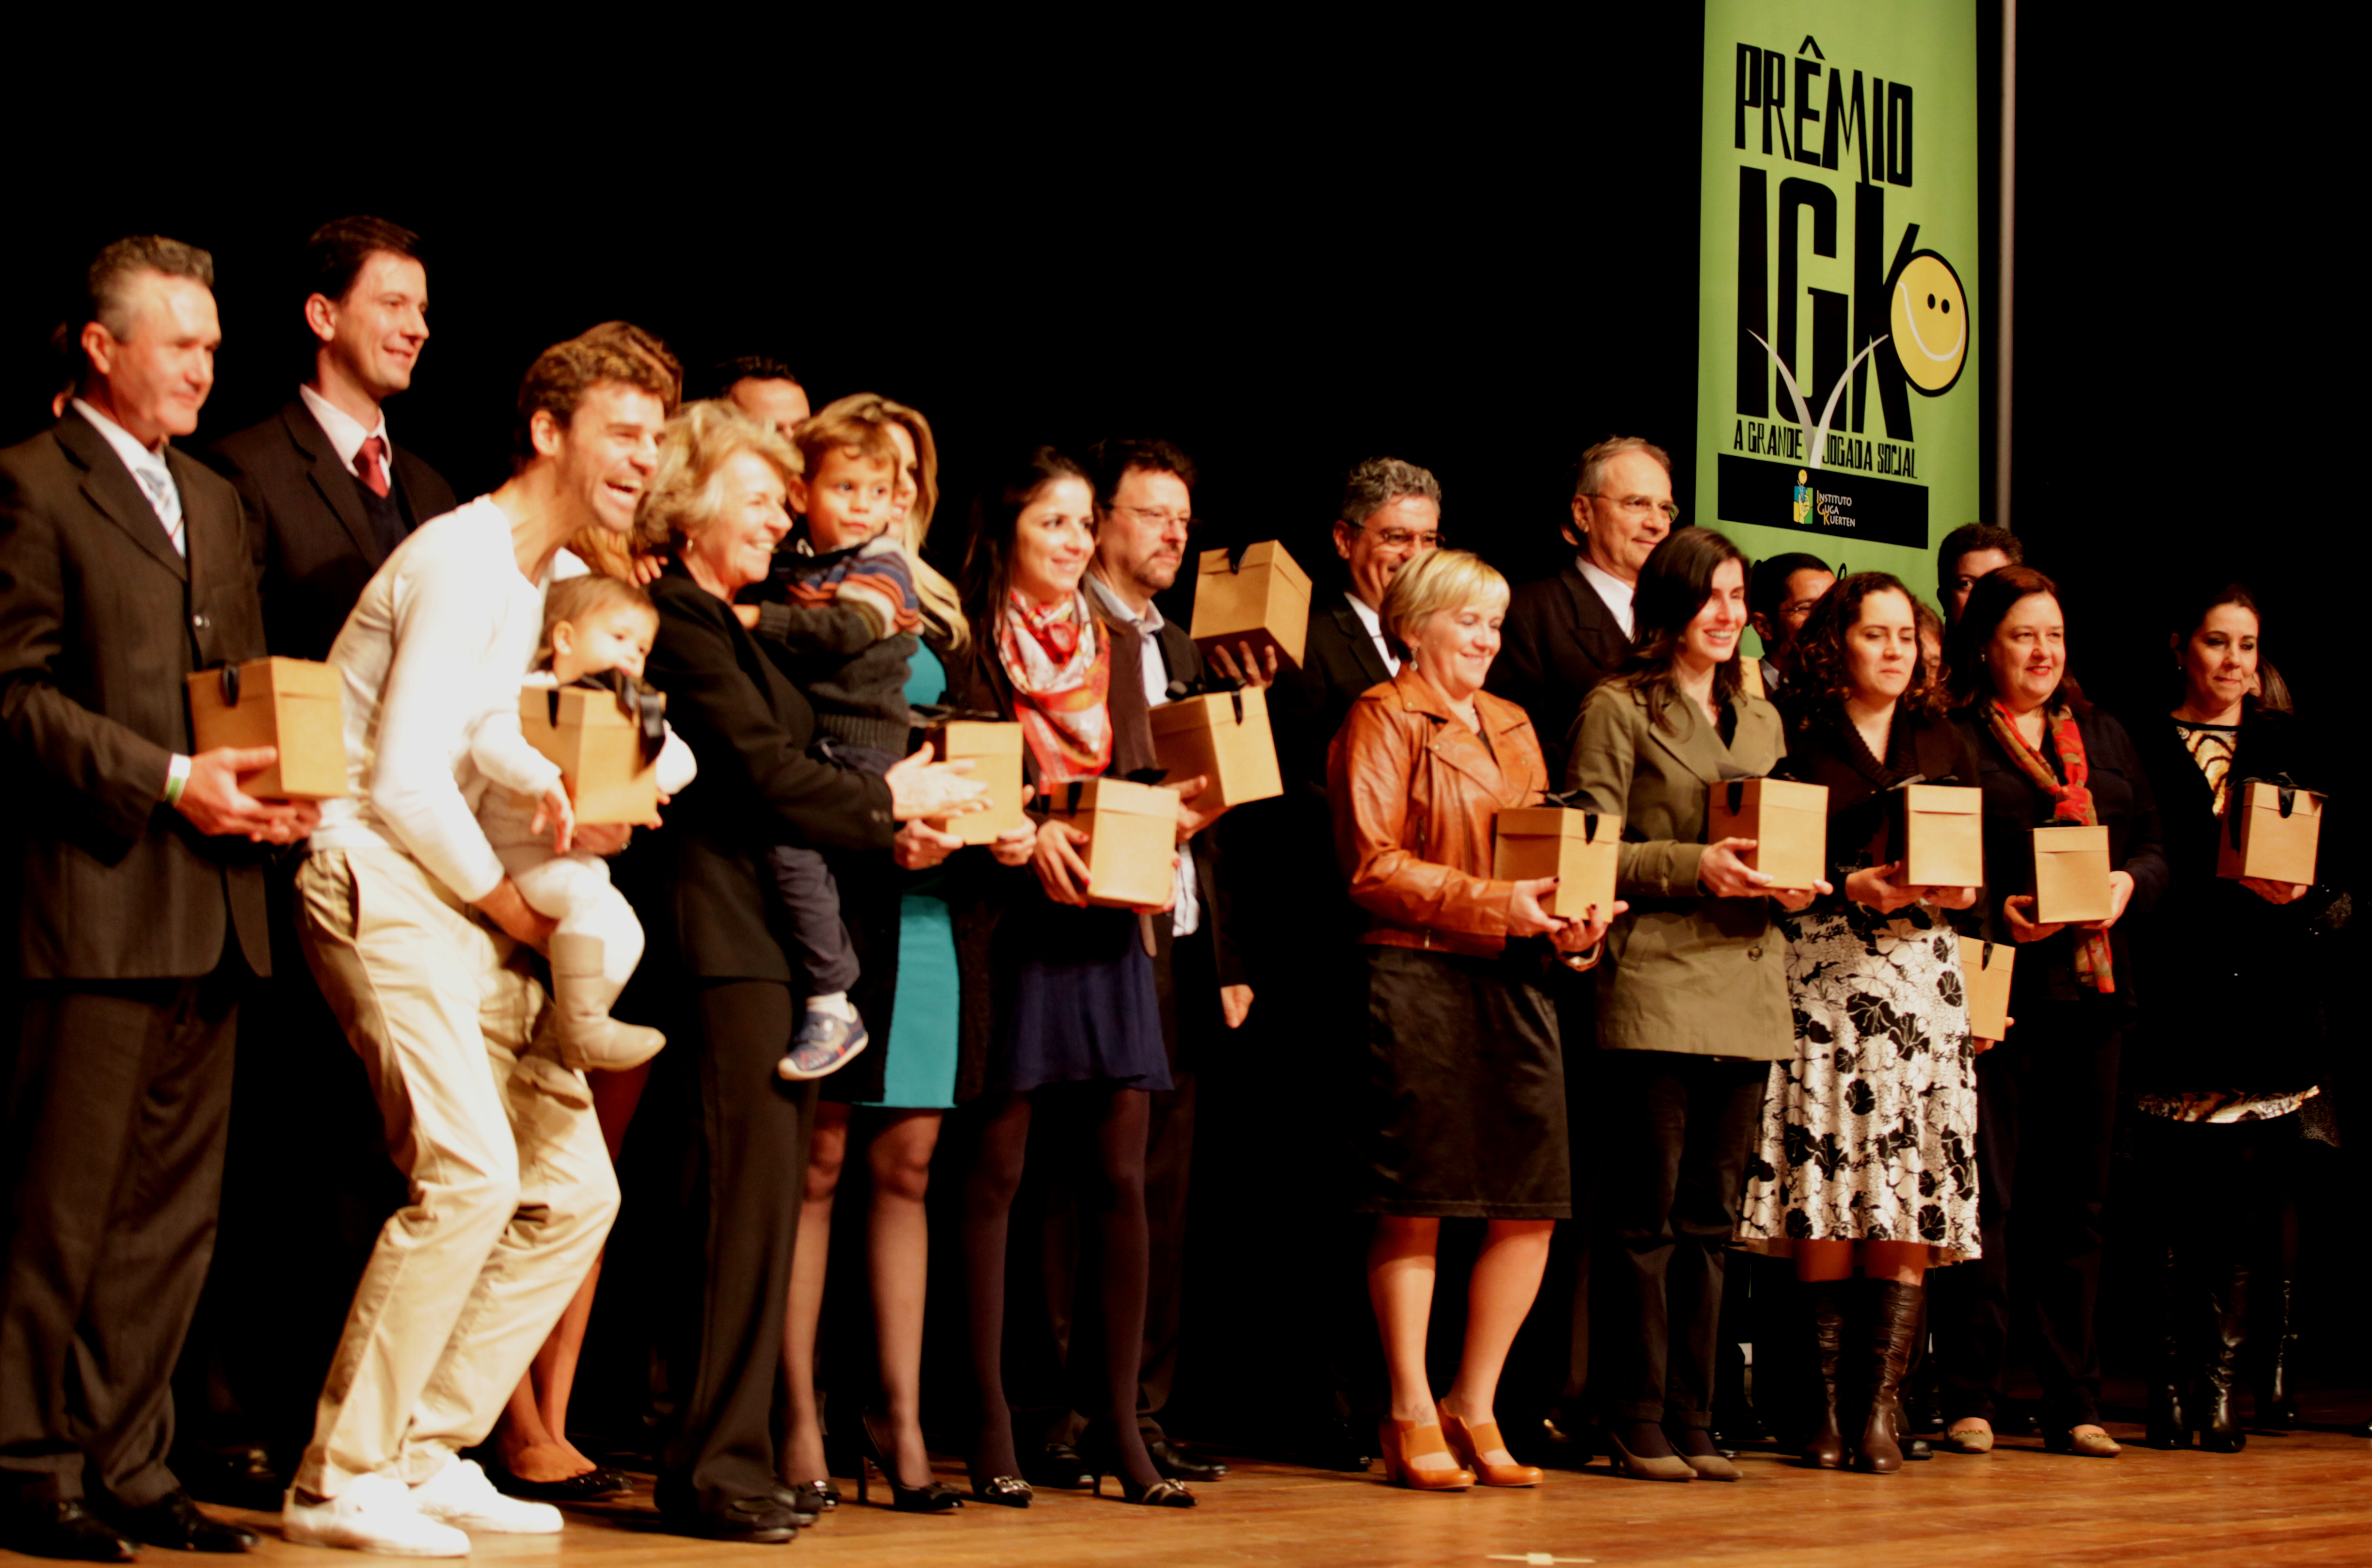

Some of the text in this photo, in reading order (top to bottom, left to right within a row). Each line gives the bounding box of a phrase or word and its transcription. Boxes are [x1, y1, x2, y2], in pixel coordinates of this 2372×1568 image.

[1735, 34, 1913, 188] PRÊMIO
[1734, 419, 1917, 479] A GRANDE JOGADA SOCIAL
[1816, 490, 1852, 507] INSTITUTO
[1817, 501, 1839, 515] GUGA
[1823, 513, 1855, 527] KUERTEN
